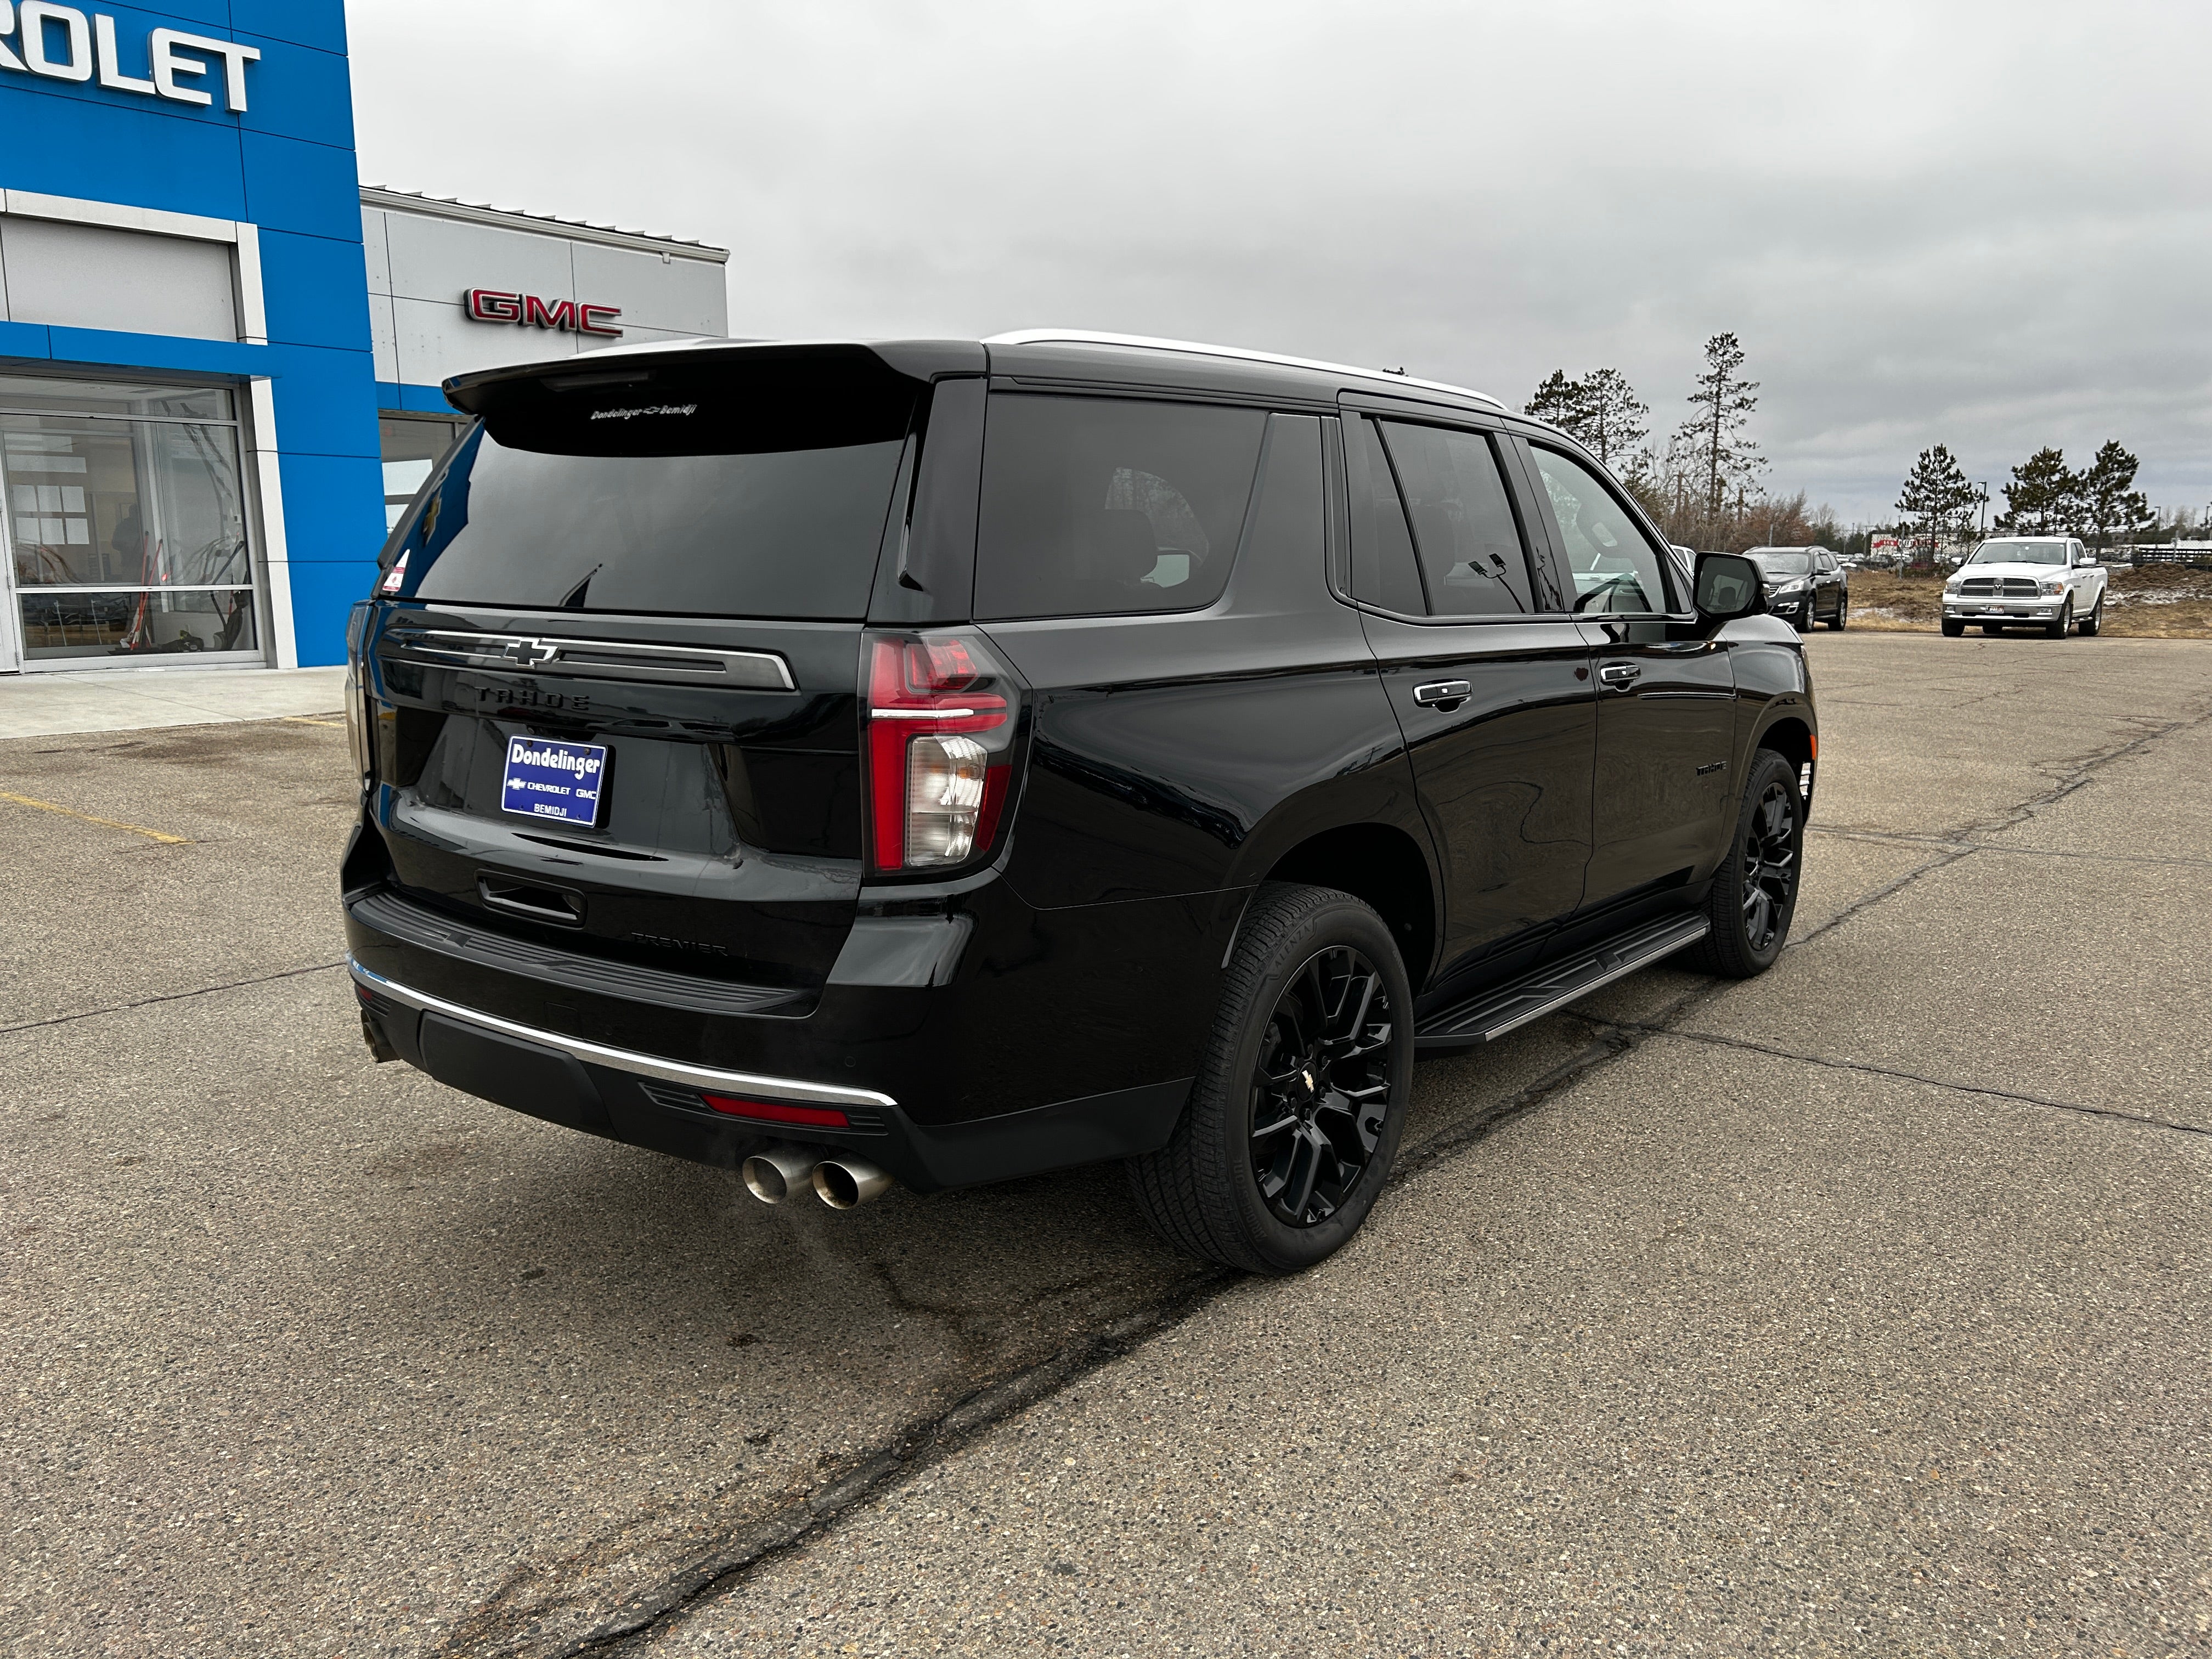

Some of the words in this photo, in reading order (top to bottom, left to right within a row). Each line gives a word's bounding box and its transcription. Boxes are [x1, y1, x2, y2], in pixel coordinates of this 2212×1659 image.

[464, 287, 623, 338] GMC
[590, 408, 643, 420] Dondelinger
[659, 404, 698, 416] Bemidji
[474, 686, 590, 711] TAHOE
[511, 743, 601, 780] Dondelinger
[527, 782, 571, 795] CHEVROLET
[575, 788, 597, 800] GMC
[533, 803, 567, 817] BEMIDJI
[631, 931, 729, 957] PREMIER
